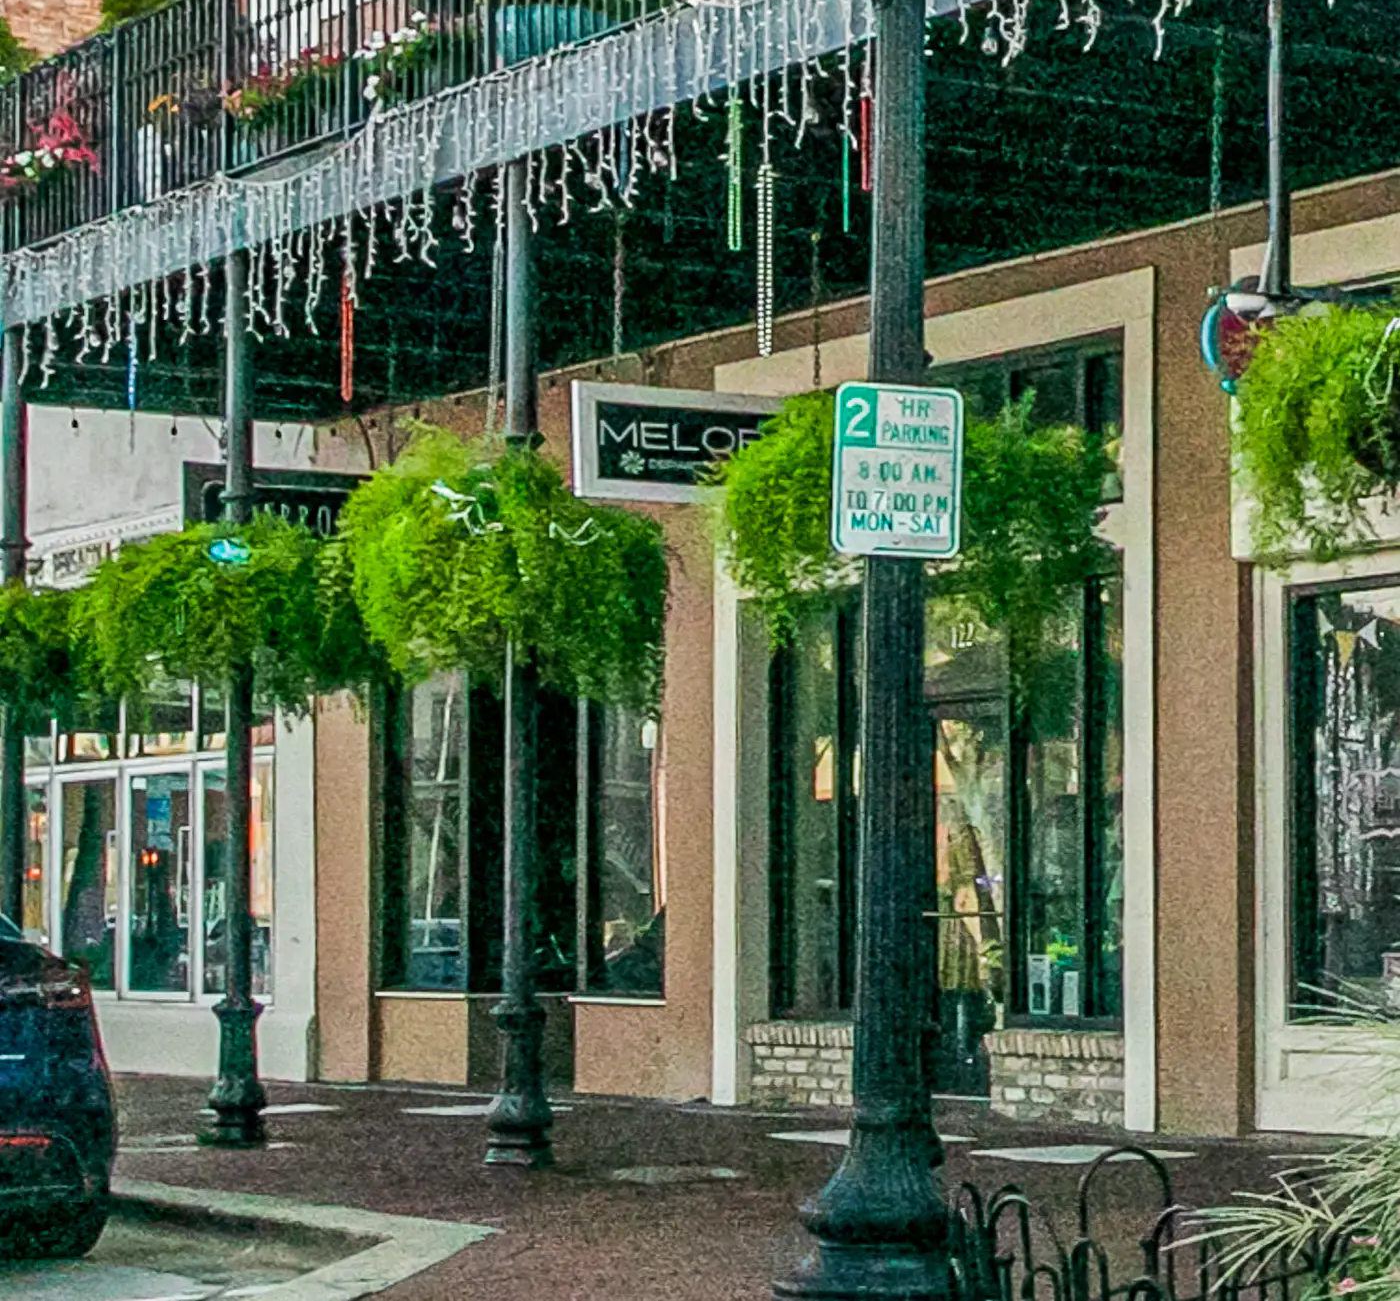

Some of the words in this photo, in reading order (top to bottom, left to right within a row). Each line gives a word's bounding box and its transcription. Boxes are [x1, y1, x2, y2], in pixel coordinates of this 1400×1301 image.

[845, 397, 871, 437] 2
[901, 399, 931, 419] HR
[882, 420, 950, 446] PARKING
[846, 490, 868, 510] TO
[873, 490, 917, 513] 7:00
